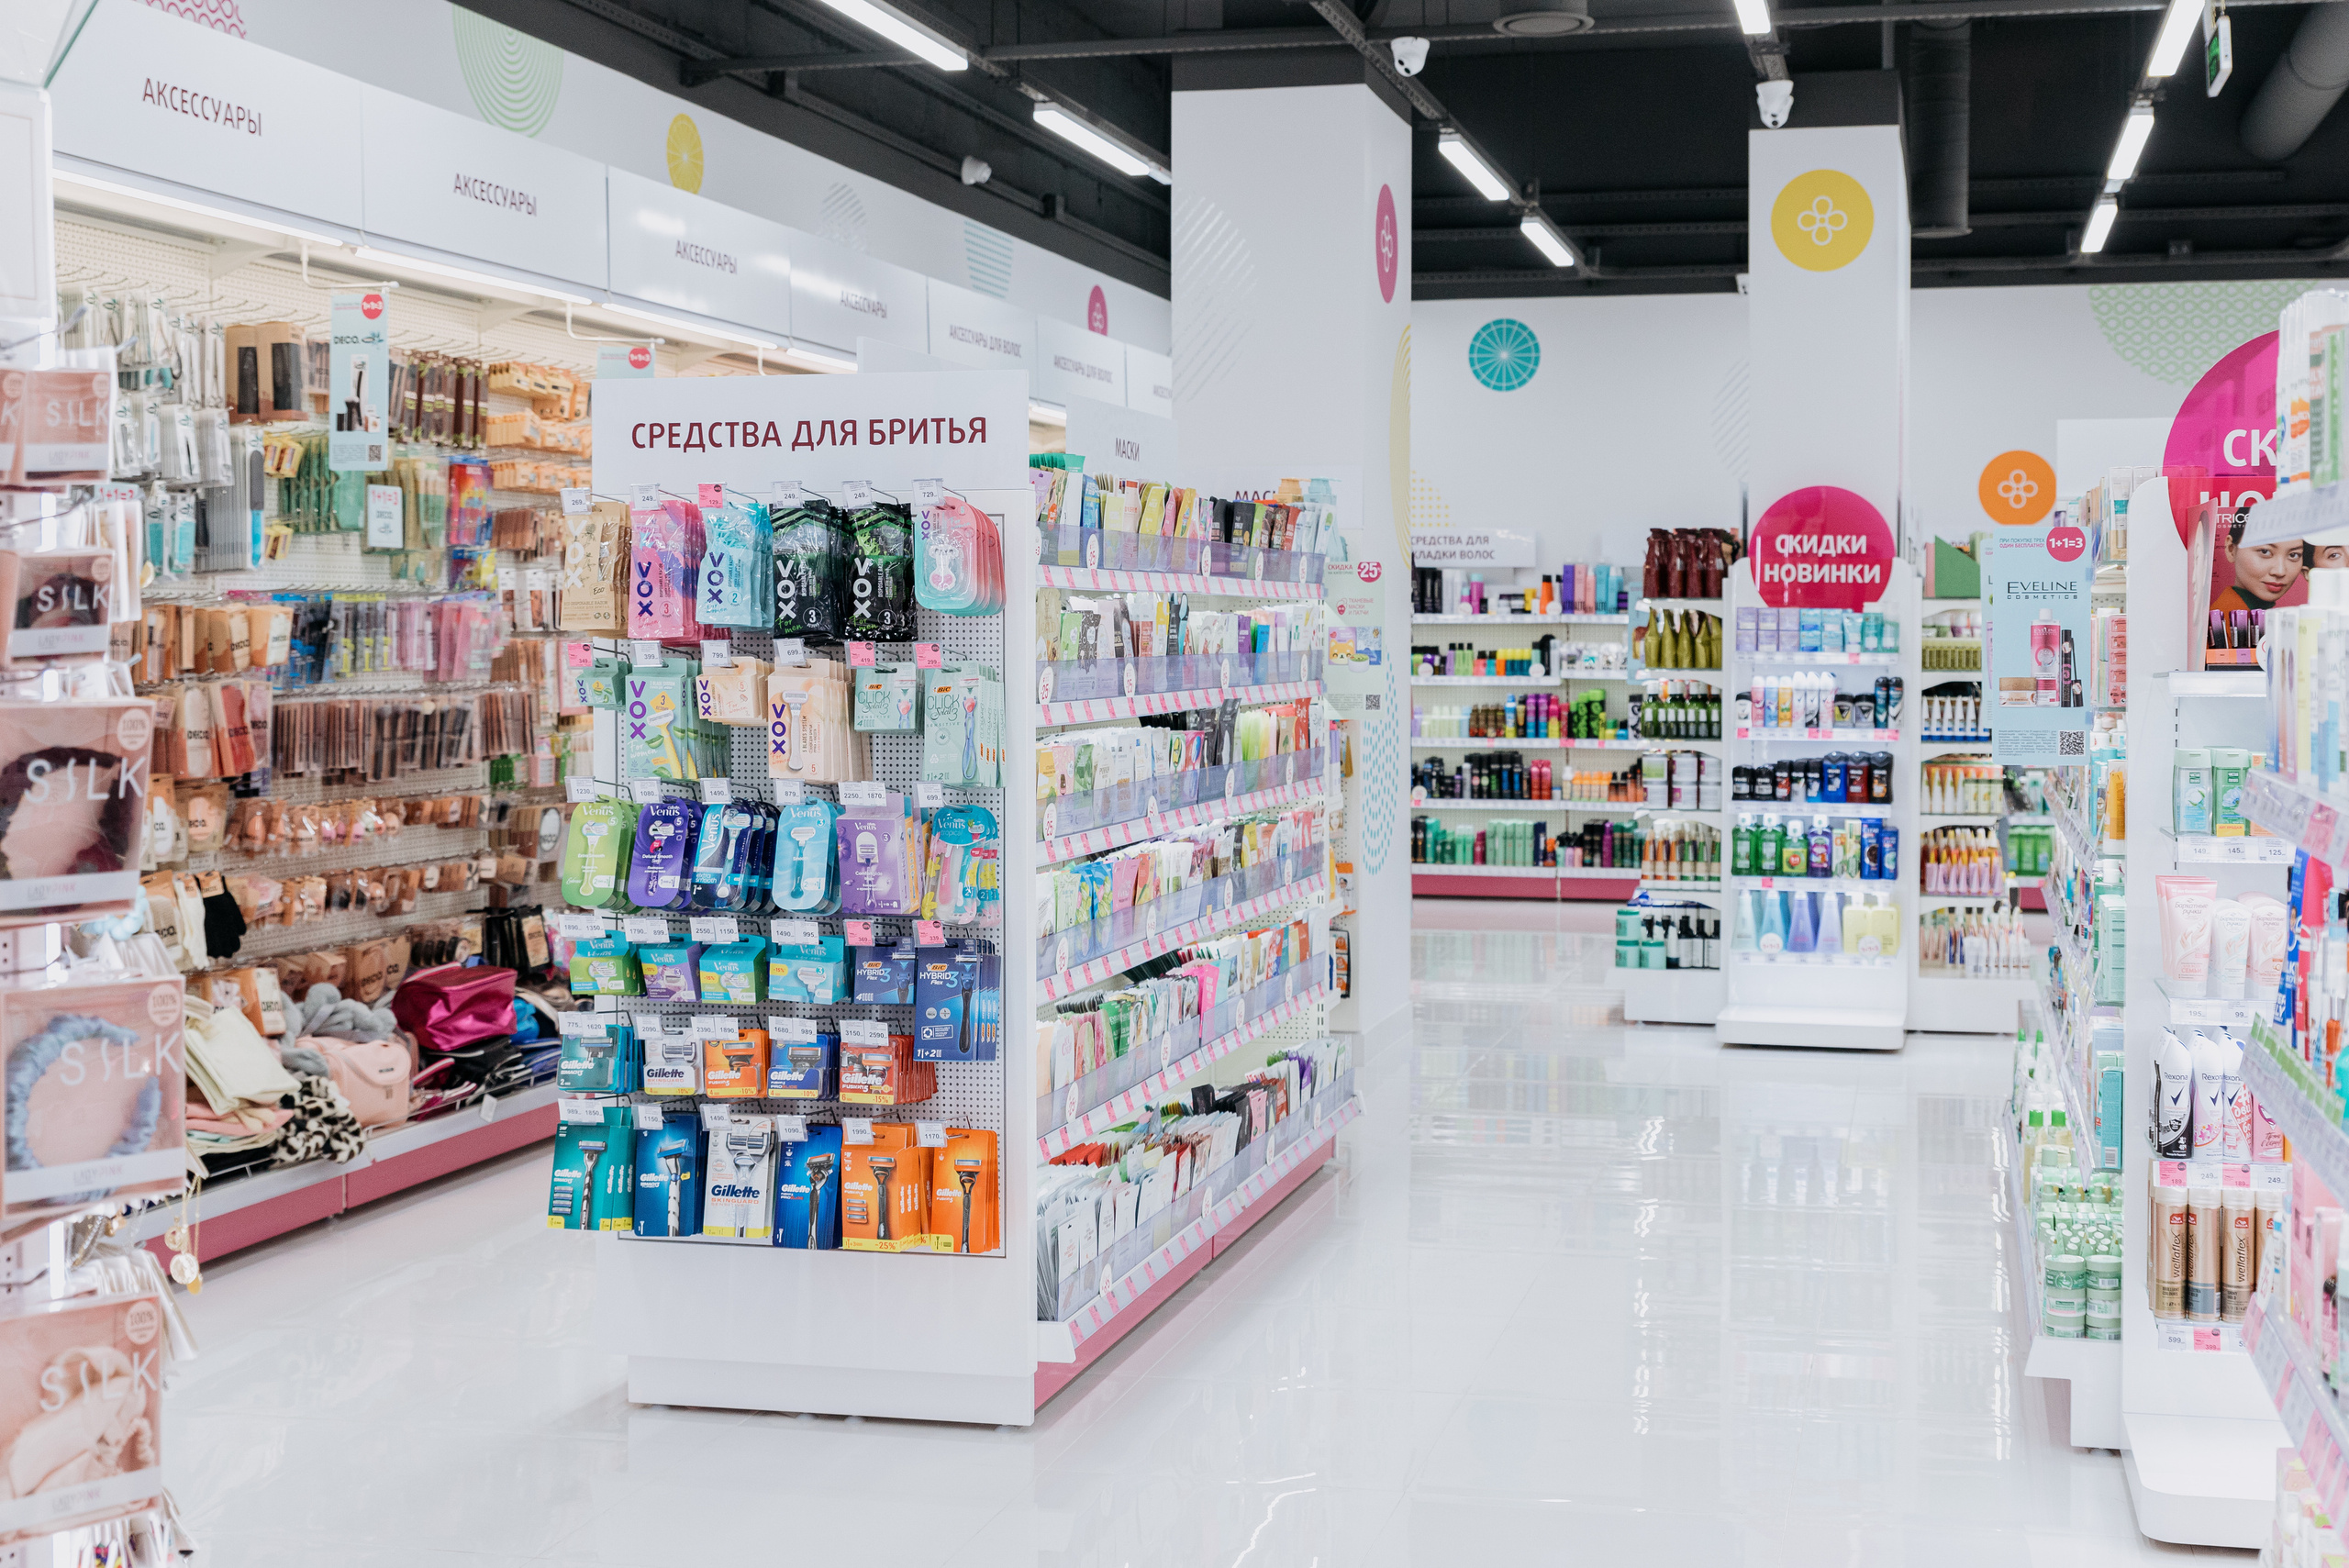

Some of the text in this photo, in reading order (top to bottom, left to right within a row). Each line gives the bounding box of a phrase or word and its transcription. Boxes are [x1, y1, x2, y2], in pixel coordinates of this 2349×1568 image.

[142, 76, 262, 137] АКСЕССУАРЫ
[453, 172, 538, 217] АКСЕССУАРЫ
[675, 239, 737, 274] АКСЕССУАРЫ
[840, 290, 887, 318] АКСЕССУАРЫ
[950, 325, 1021, 358] АКСЕССУАРЫ ДЛЯ ВОЛОС
[1054, 354, 1113, 384] АКСЕССУАРЫ ДЛЯ ВОЛОС
[46, 400, 109, 428] SILK
[631, 417, 986, 453] СРЕДСТВА ДЛЯ БРИТЬЯ
[1115, 438, 1140, 462] МАСКИ
[921, 510, 930, 540] VOX
[1411, 536, 1489, 545] СРЕДСТВА ДЛЯ
[1776, 534, 1867, 556] СКИДКИ
[2049, 538, 2083, 548] 1+1=3
[565, 519, 587, 589] VOX
[1413, 550, 1456, 560] КЛАДКИ
[707, 552, 724, 605] VOX
[1765, 563, 1880, 584] НОВИНКИ
[593, 586, 605, 595] Eco
[637, 562, 653, 617] VOX
[775, 560, 796, 619] VOX
[853, 557, 872, 618] VOX
[2008, 582, 2077, 594] EVELINE
[36, 584, 110, 613] SILK
[577, 679, 587, 703] VOX
[699, 680, 712, 717] VOX
[629, 680, 647, 740] VOX
[772, 703, 786, 755] VOX
[628, 739, 644, 752] For
[629, 749, 658, 759] women
[24, 756, 146, 804] SILK
[583, 805, 614, 816] Venus
[650, 805, 680, 817] Venus
[790, 807, 822, 817] Venus
[854, 821, 877, 830] Venus
[937, 817, 965, 829] Venus
[699, 813, 721, 855] Venus
[589, 940, 615, 949] Venus
[799, 945, 826, 955] Venus
[651, 953, 675, 963] Venus
[714, 962, 740, 972] Venus
[880, 967, 891, 983] 3
[919, 971, 959, 988] HYBRID 3
[60, 1031, 181, 1086] SILK
[561, 1060, 595, 1070] Gillette
[646, 1068, 685, 1078] Gillette
[707, 1070, 740, 1081] Gillette
[770, 1071, 805, 1081] Gillette
[842, 1073, 883, 1085] Gillette
[2165, 1073, 2188, 1081] Rexona
[554, 1169, 582, 1178] Gillette
[640, 1173, 669, 1183] Gillette
[711, 1184, 760, 1199] Gillette
[781, 1184, 810, 1194] Gillette
[844, 1182, 873, 1192] Gillette
[936, 1188, 963, 1198] Gillette
[2171, 1228, 2181, 1278] wellaflex
[2236, 1232, 2246, 1282] wellaflex
[39, 1348, 158, 1412] SILK
